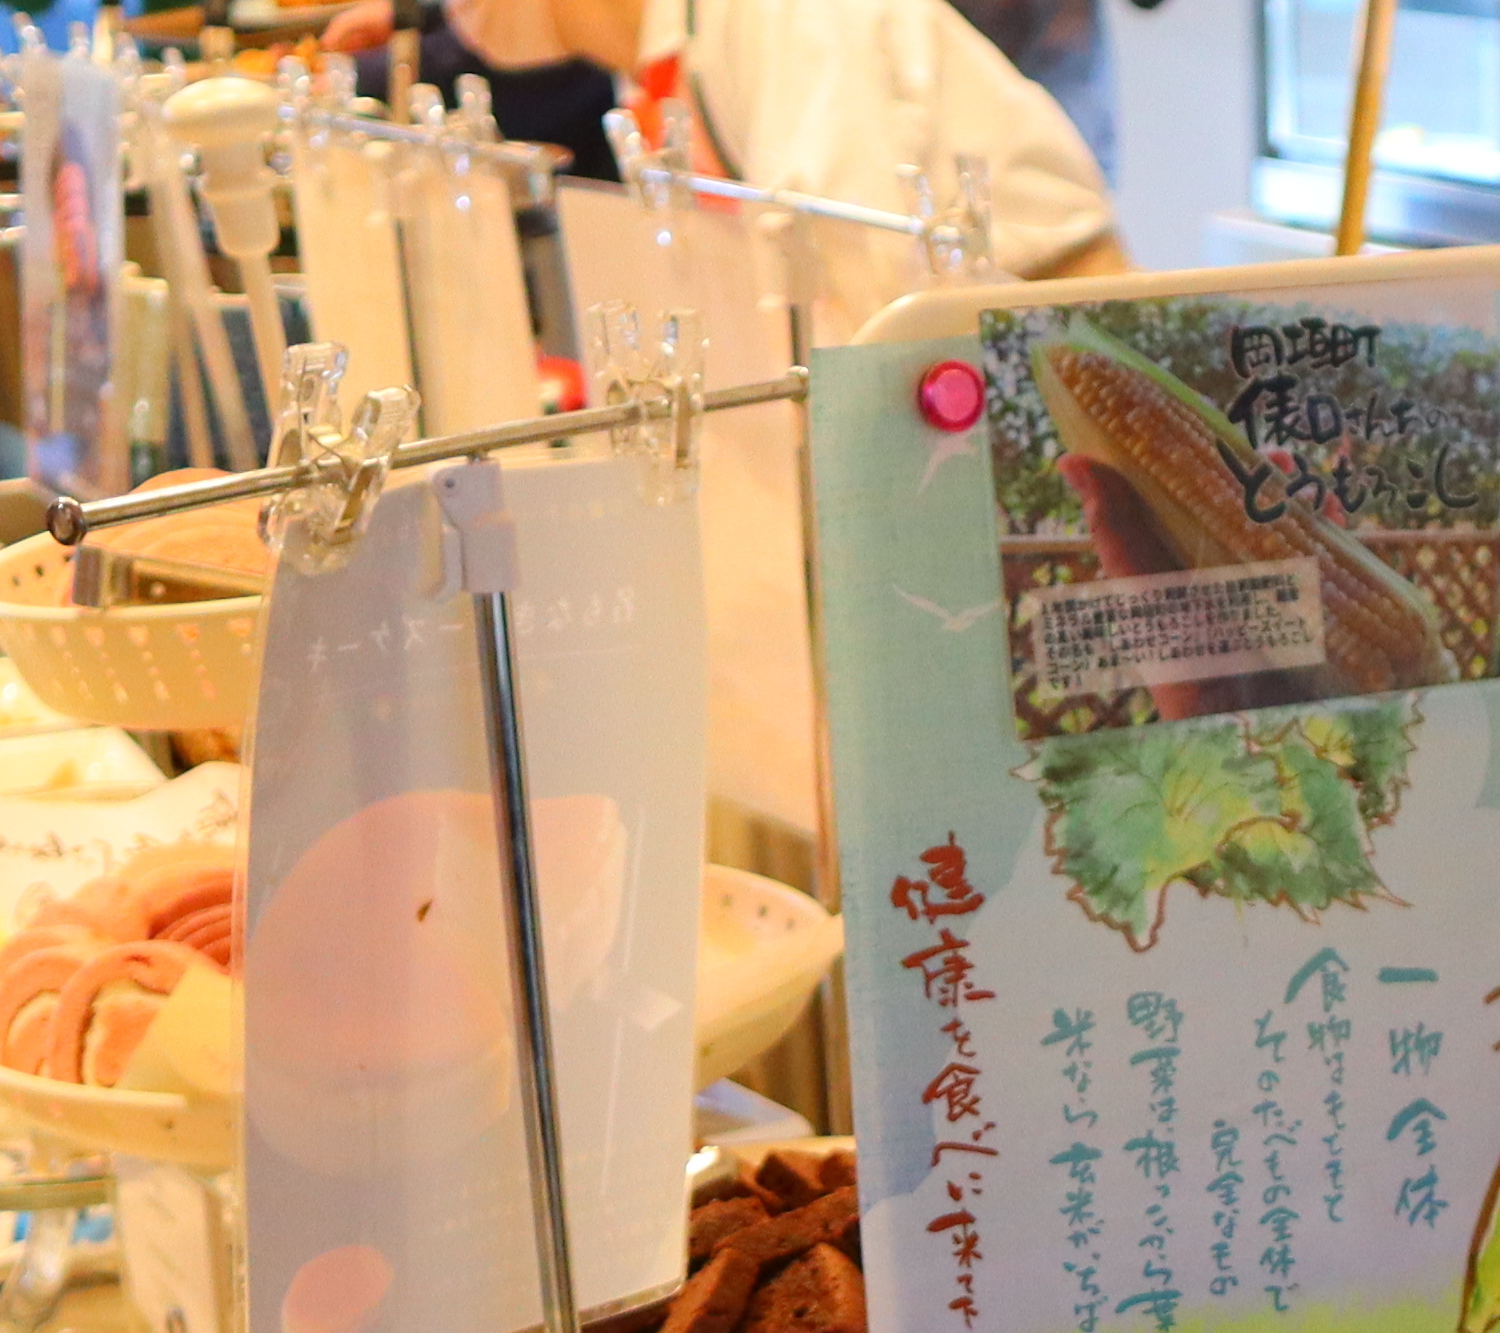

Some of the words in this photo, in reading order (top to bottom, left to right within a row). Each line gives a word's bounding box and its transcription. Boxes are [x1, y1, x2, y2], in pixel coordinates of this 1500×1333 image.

[1216, 439, 1478, 525] とうもろこし
[1252, 1010, 1302, 1312] そのたべもの全体で
[1378, 967, 1448, 1228] 一物全体
[1206, 1119, 1244, 1296] 完全なもの
